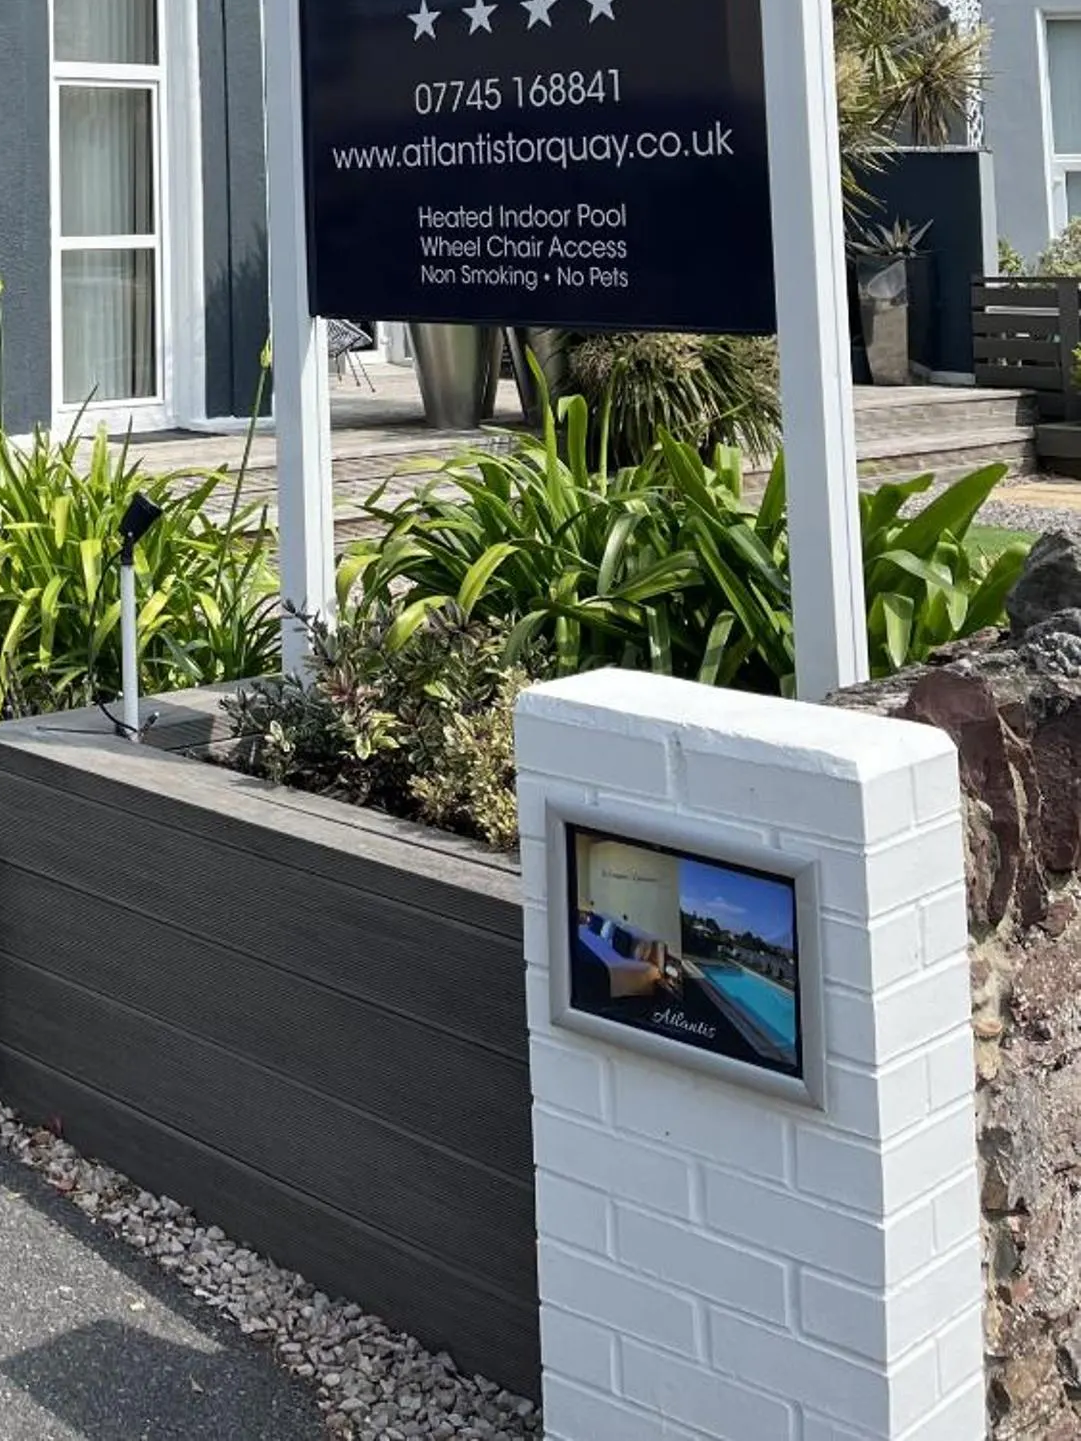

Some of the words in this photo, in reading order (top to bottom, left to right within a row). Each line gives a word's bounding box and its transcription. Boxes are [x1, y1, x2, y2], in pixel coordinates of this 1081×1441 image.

[415, 78, 502, 115] 07745
[512, 68, 620, 108] 168841
[332, 121, 734, 169] www.atlantistorquay.co.uk
[419, 205, 493, 228] Heated
[499, 204, 571, 228] Indoor
[577, 203, 626, 227] Pool
[420, 236, 481, 257] Wheel
[486, 235, 544, 258] Chair
[548, 235, 627, 259] Access
[421, 264, 456, 284] Non
[461, 264, 538, 291] Smoking
[557, 266, 585, 286] No
[589, 266, 629, 288] Pets
[651, 1008, 717, 1039] Atlantis
